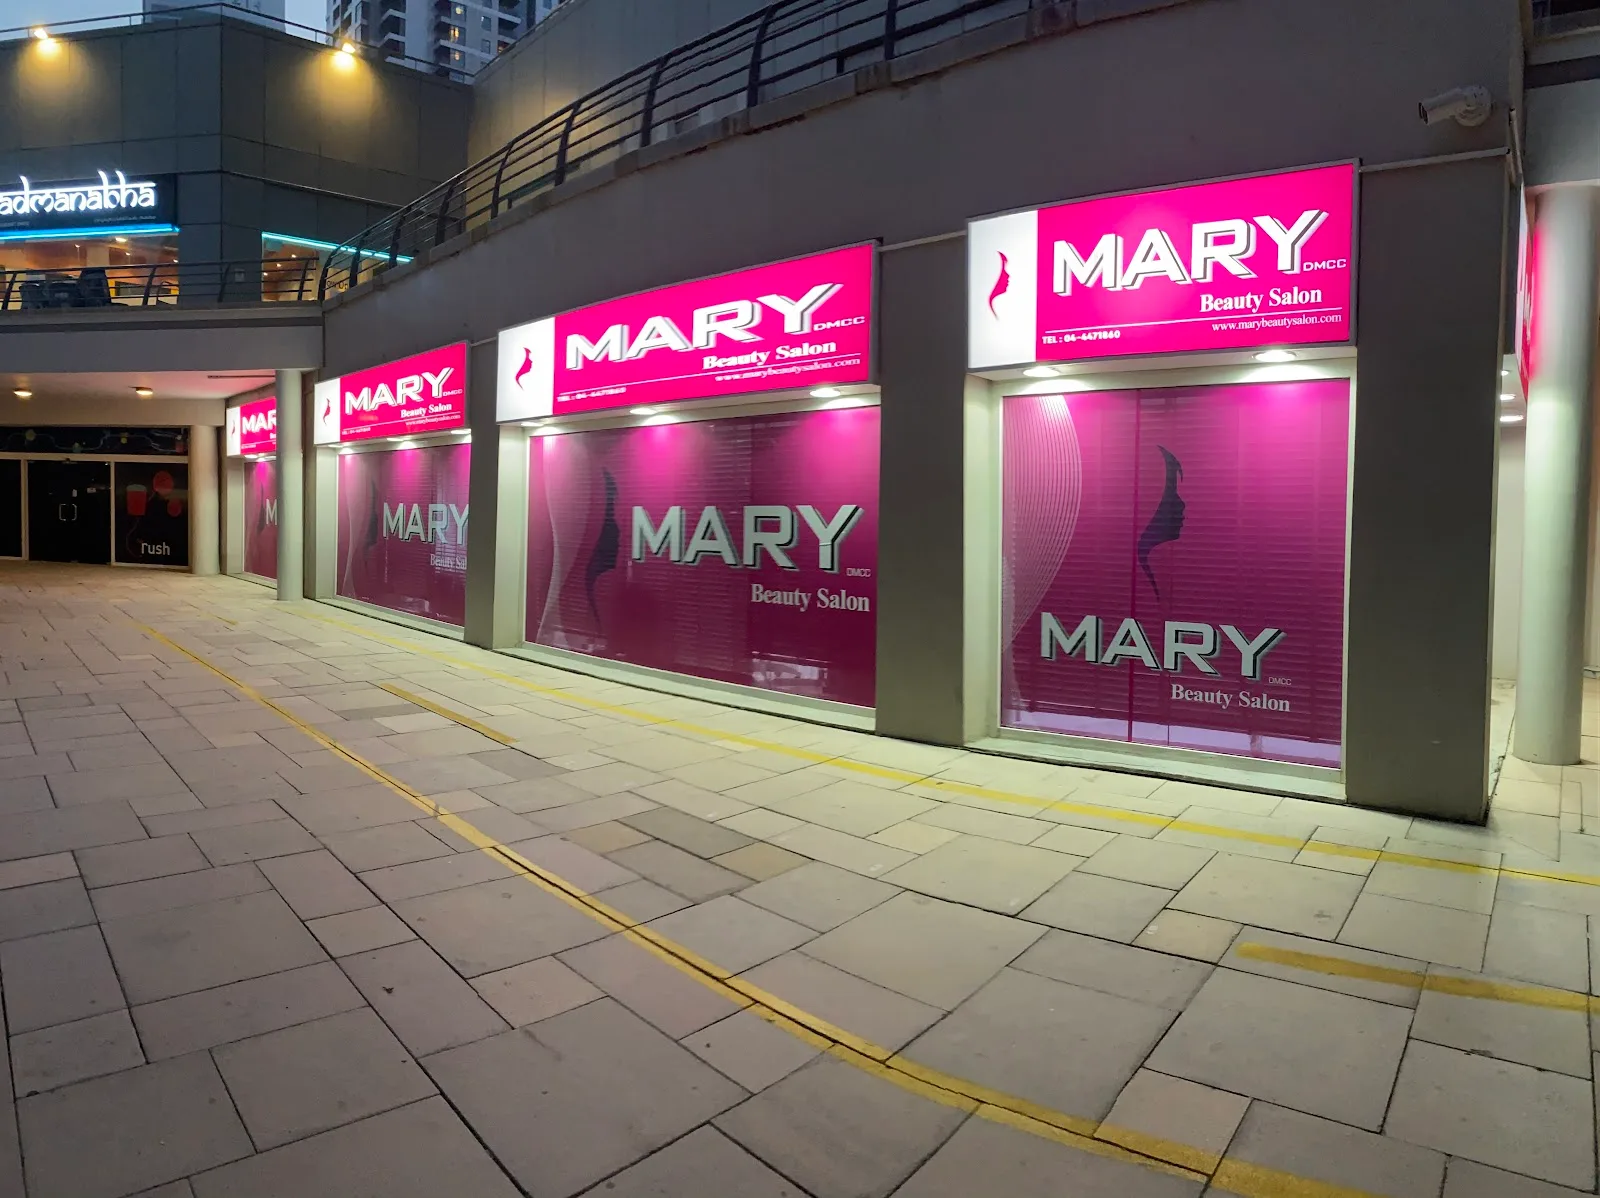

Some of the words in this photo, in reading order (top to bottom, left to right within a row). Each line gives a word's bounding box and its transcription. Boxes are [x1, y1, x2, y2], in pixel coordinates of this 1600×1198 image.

[1052, 209, 1330, 297] MARY
[1303, 258, 1347, 272] DMCC
[1199, 291, 1264, 313] Beauty
[1268, 286, 1322, 307] Salon
[566, 282, 844, 371] MARY
[813, 316, 865, 331] DMCC
[1212, 314, 1342, 331] www.marybeautysalon.com
[702, 350, 771, 370] Beauty
[775, 341, 837, 360] Salon
[345, 367, 455, 415] MARY
[242, 409, 276, 435] MAR
[400, 407, 427, 418] Beauty
[428, 403, 452, 414] Salon
[383, 502, 469, 547] MARY
[140, 542, 171, 556] rush
[632, 504, 865, 574] MARY
[455, 555, 467, 570] Sal
[846, 567, 871, 578] DMCC
[750, 583, 812, 612] Beauty
[816, 588, 870, 612] Salon
[1041, 611, 1287, 681] MARY
[1268, 676, 1292, 686] DMCC
[1171, 683, 1233, 709] Beauty
[1238, 691, 1290, 713] Salon
